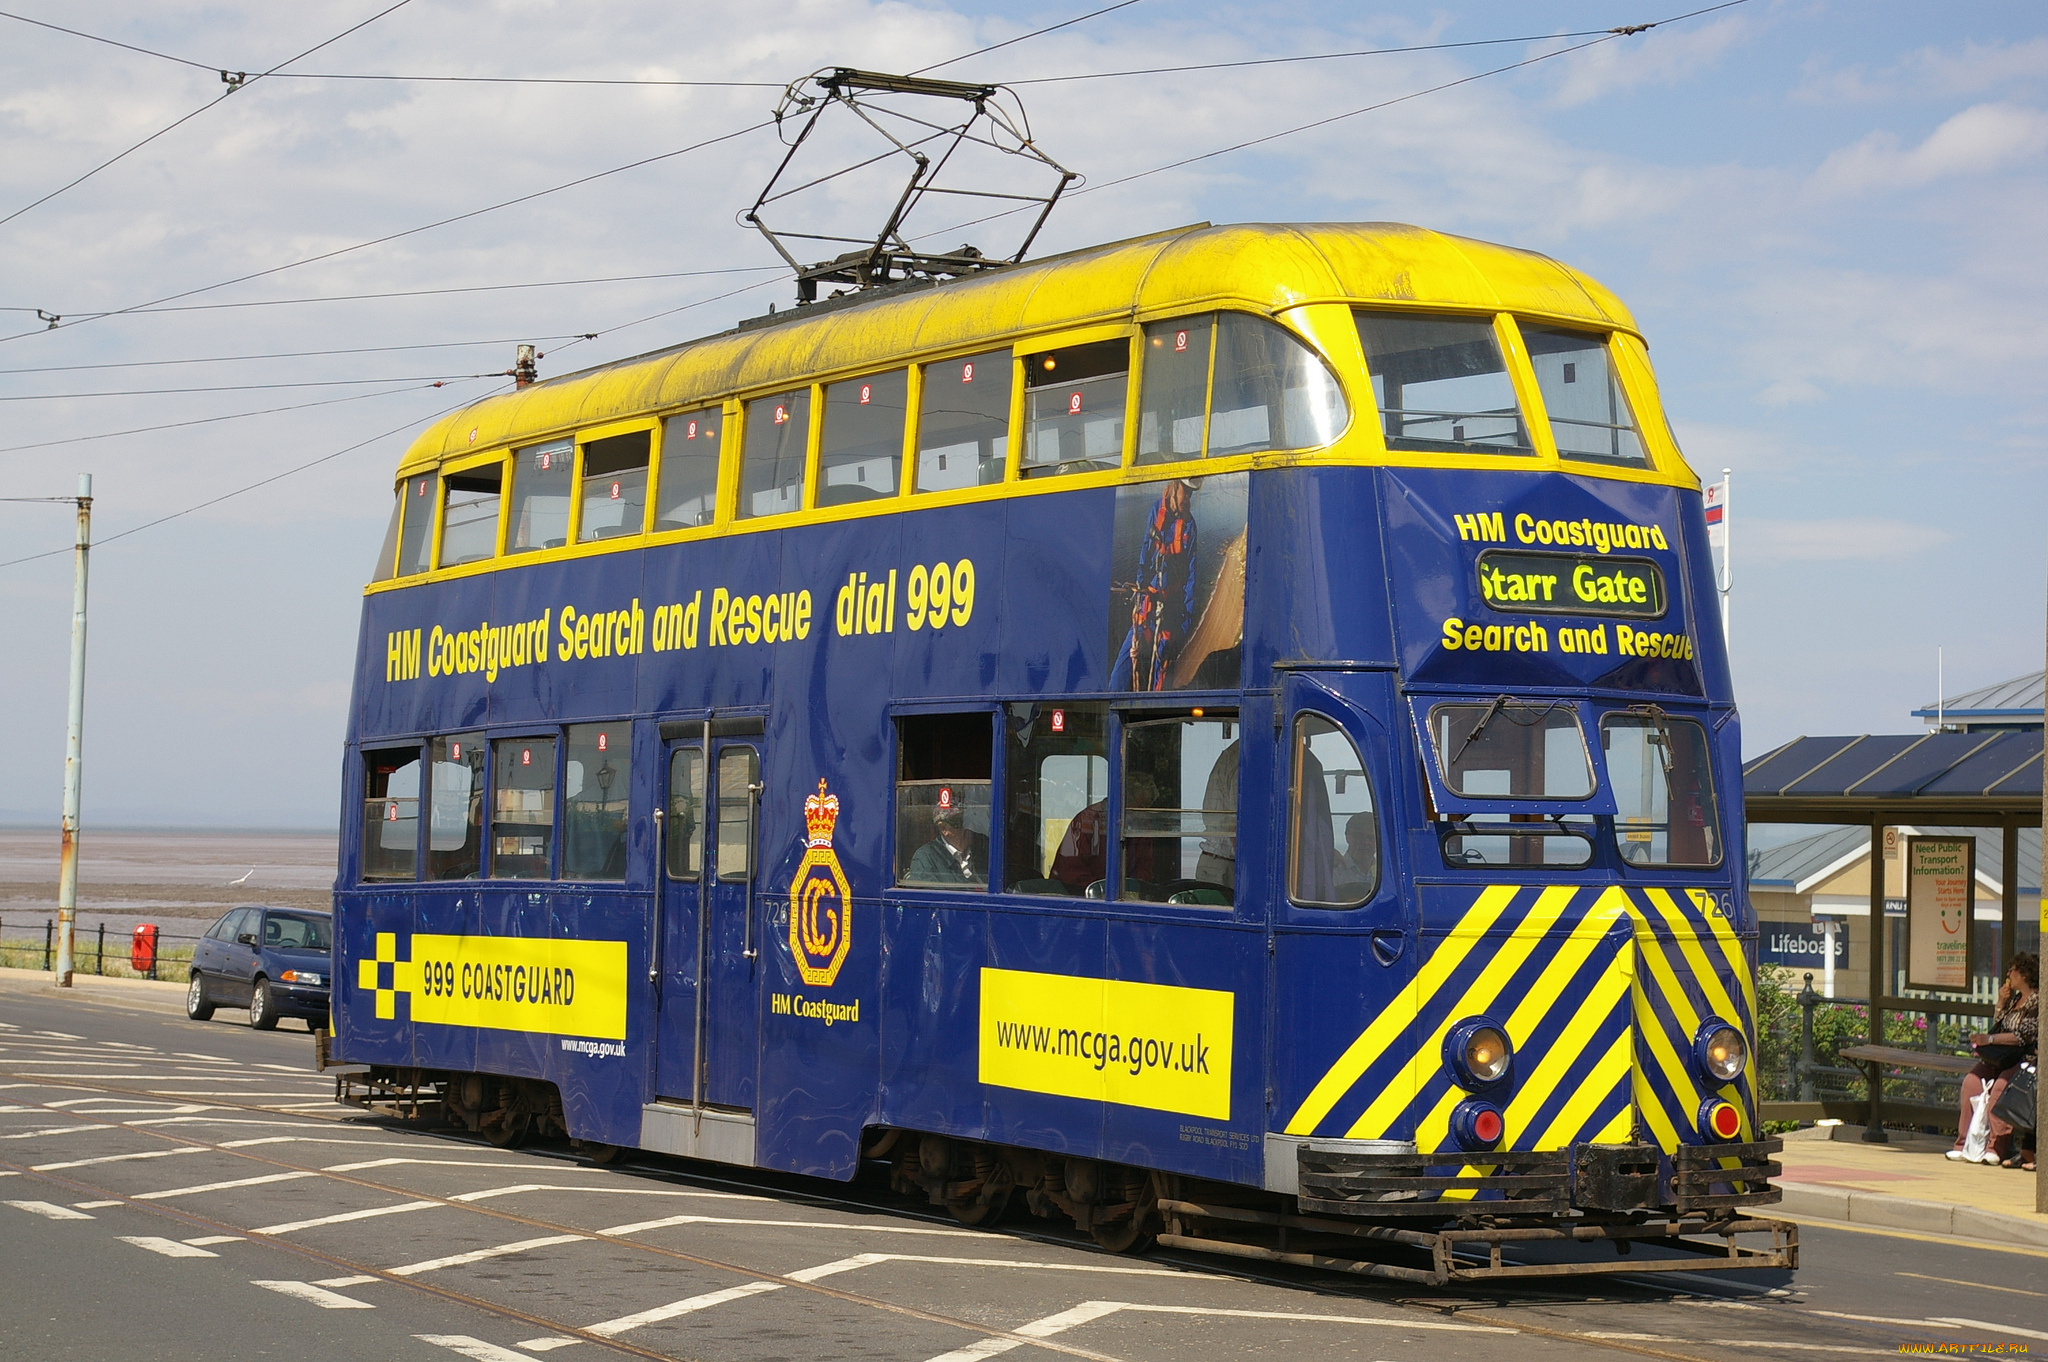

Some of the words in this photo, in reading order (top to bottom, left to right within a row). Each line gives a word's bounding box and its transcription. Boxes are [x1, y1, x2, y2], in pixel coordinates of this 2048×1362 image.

[1453, 512, 1506, 542] HM
[1515, 513, 1668, 553] Coastguard
[1481, 562, 1557, 601] Starr
[1572, 564, 1647, 604] Gate
[386, 628, 421, 682] HM
[428, 607, 550, 683] Coastguard
[558, 598, 644, 662] Search
[653, 590, 701, 652] and
[709, 587, 812, 647] Rescue
[836, 568, 896, 637] dial
[907, 558, 975, 631] 999
[1441, 617, 1548, 652] Search
[1558, 624, 1608, 655] and
[1616, 624, 1694, 660] Rescue
[1916, 843, 1936, 853] Need
[1938, 842, 1962, 853] Public
[1913, 865, 1965, 876] Information?
[1920, 855, 1958, 866] Transport
[764, 901, 788, 924] 726
[1694, 892, 1734, 919] 726
[1771, 933, 1843, 956] Lifeboas
[422, 960, 455, 997] 999
[461, 962, 576, 1007] COASTGUARD
[771, 993, 791, 1015] HM
[793, 994, 860, 1026] Coastguard
[561, 1039, 626, 1059] www.mcga.gov.uk
[996, 1020, 1210, 1075] www.mcga.gov.uk
[1180, 1125, 1203, 1135] BLACKPOOL
[1204, 1127, 1228, 1138] TRANSPORT
[1228, 1131, 1250, 1142] SERVICES
[1250, 1135, 1260, 1143] LTD
[1205, 1137, 1229, 1148] BLACKPOOL
